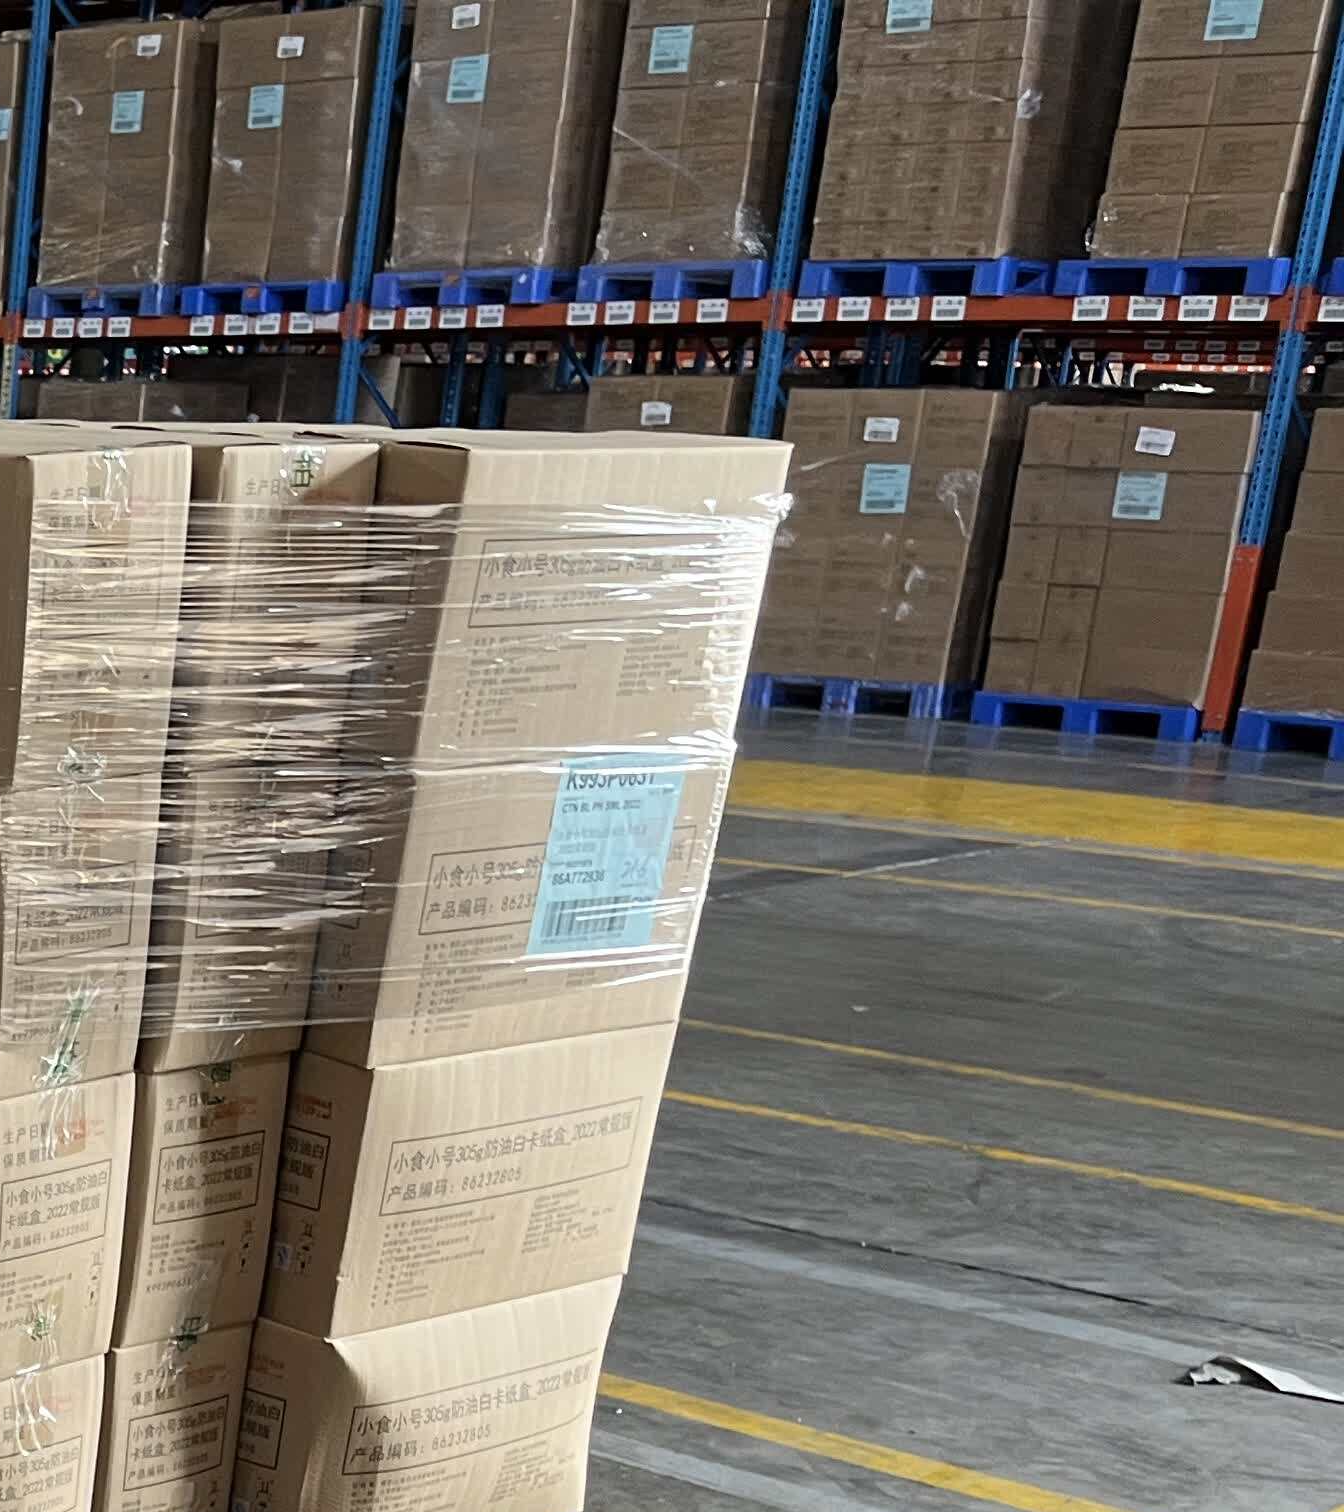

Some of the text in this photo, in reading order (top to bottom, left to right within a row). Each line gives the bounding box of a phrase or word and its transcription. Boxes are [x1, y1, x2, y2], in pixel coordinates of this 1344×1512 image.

[392, 1110, 634, 1175] 小食小号305g防油白卡纸盒_2022常规版
[386, 1165, 523, 1203] 产品编码：86232805
[349, 1423, 492, 1465] 产品编码：86232805
